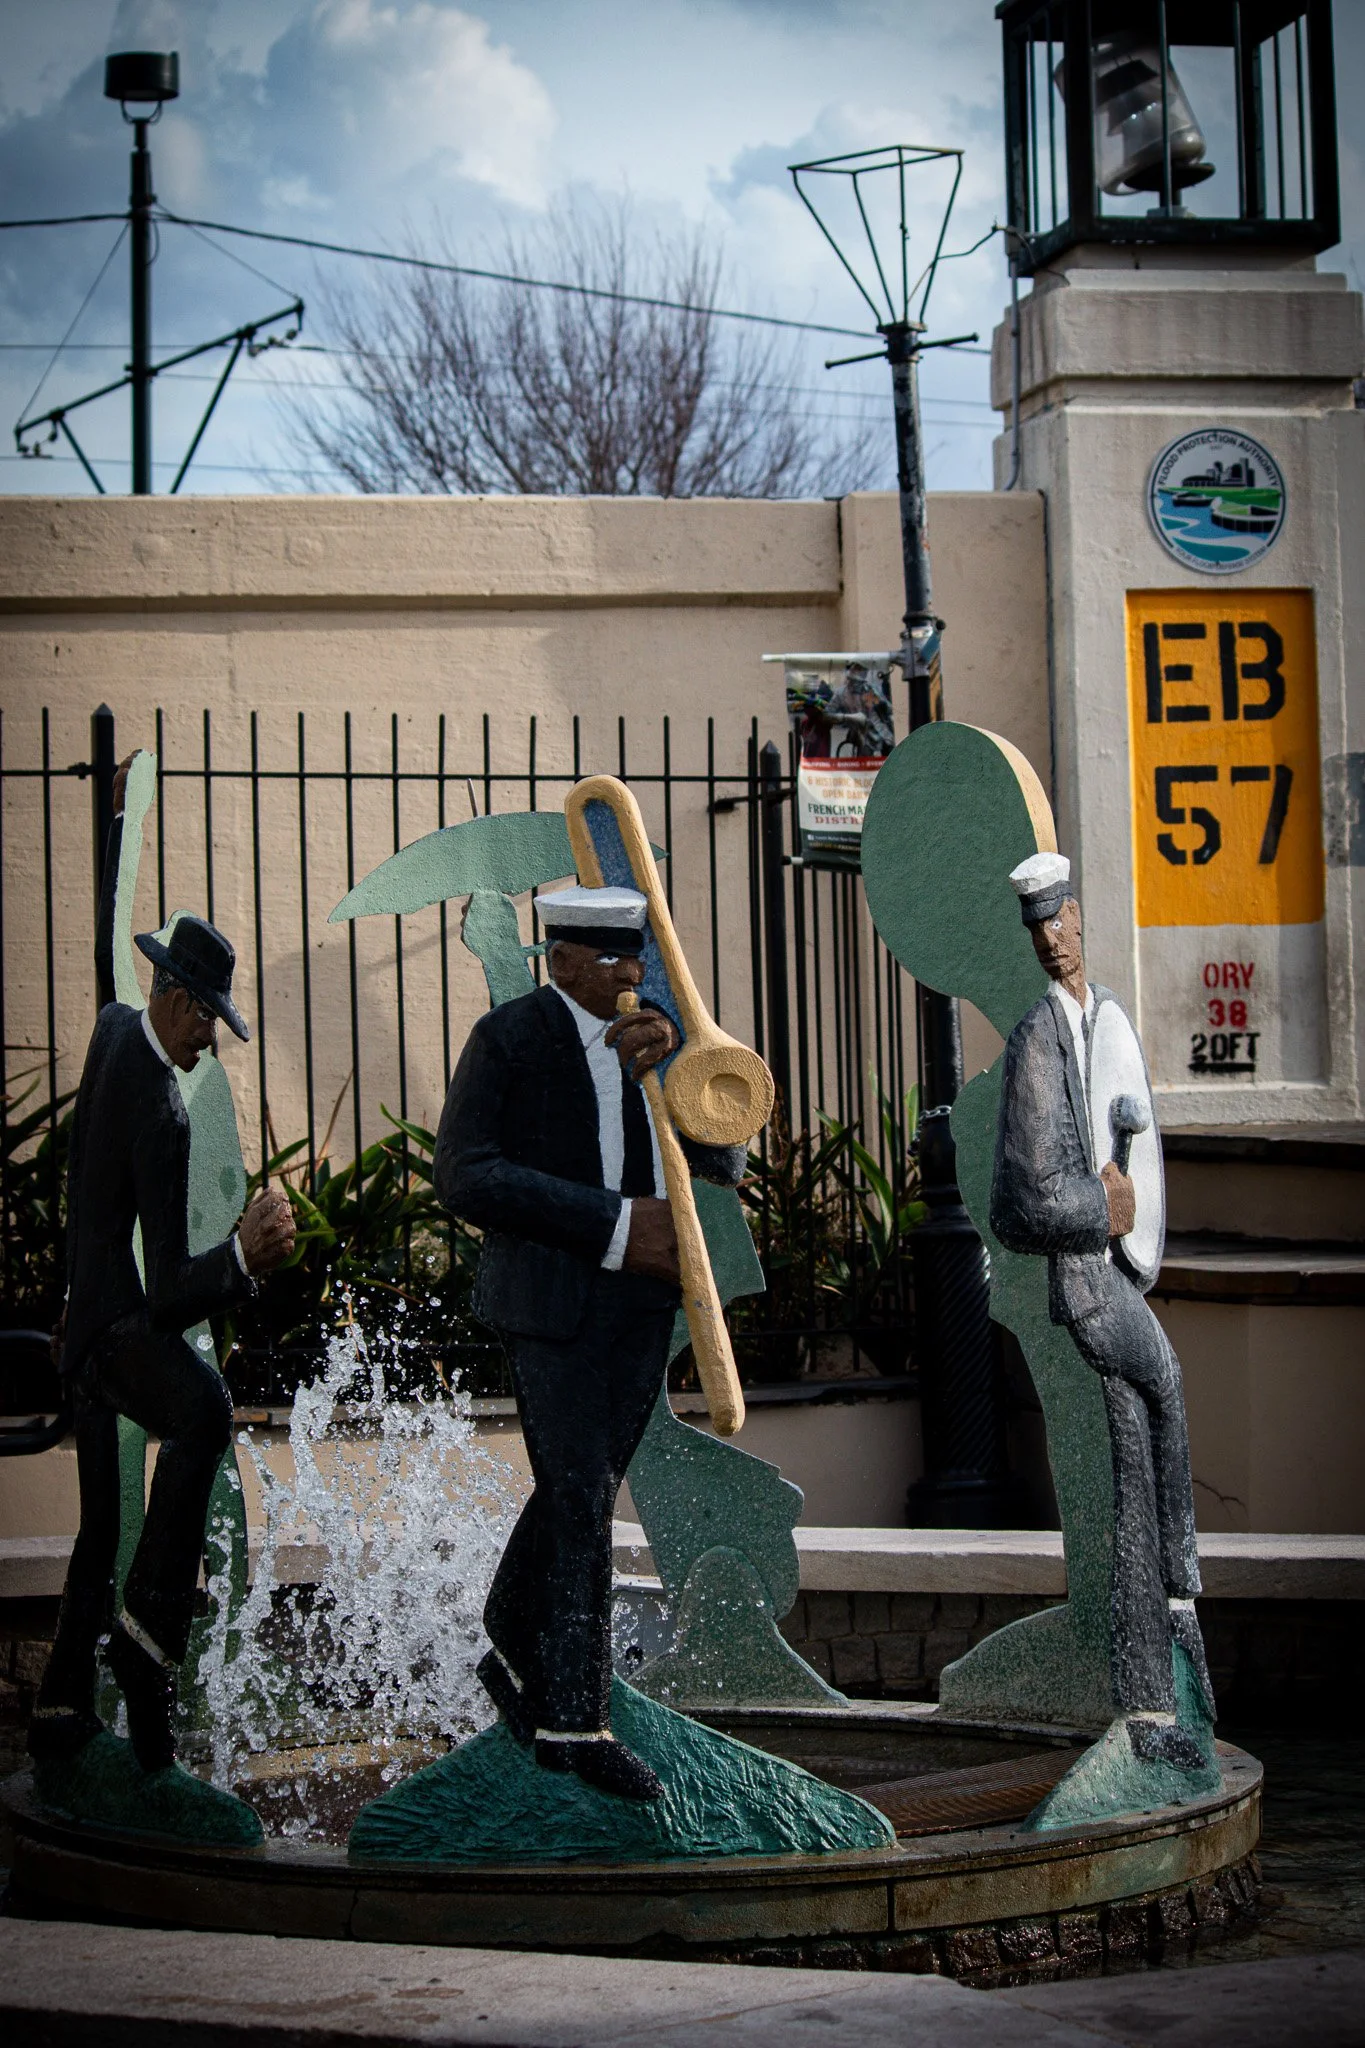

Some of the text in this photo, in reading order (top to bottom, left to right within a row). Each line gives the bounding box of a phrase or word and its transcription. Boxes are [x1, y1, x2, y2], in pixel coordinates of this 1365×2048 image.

[1158, 433, 1279, 487] FLOOD PROTECTION AUTHORITY
[1143, 621, 1286, 723] EB
[808, 804, 866, 815] FRENCH MA
[1154, 764, 1294, 866] 57
[1203, 962, 1256, 990] ORY
[1208, 998, 1248, 1028] 38
[1190, 1032, 1261, 1062] 20FT
